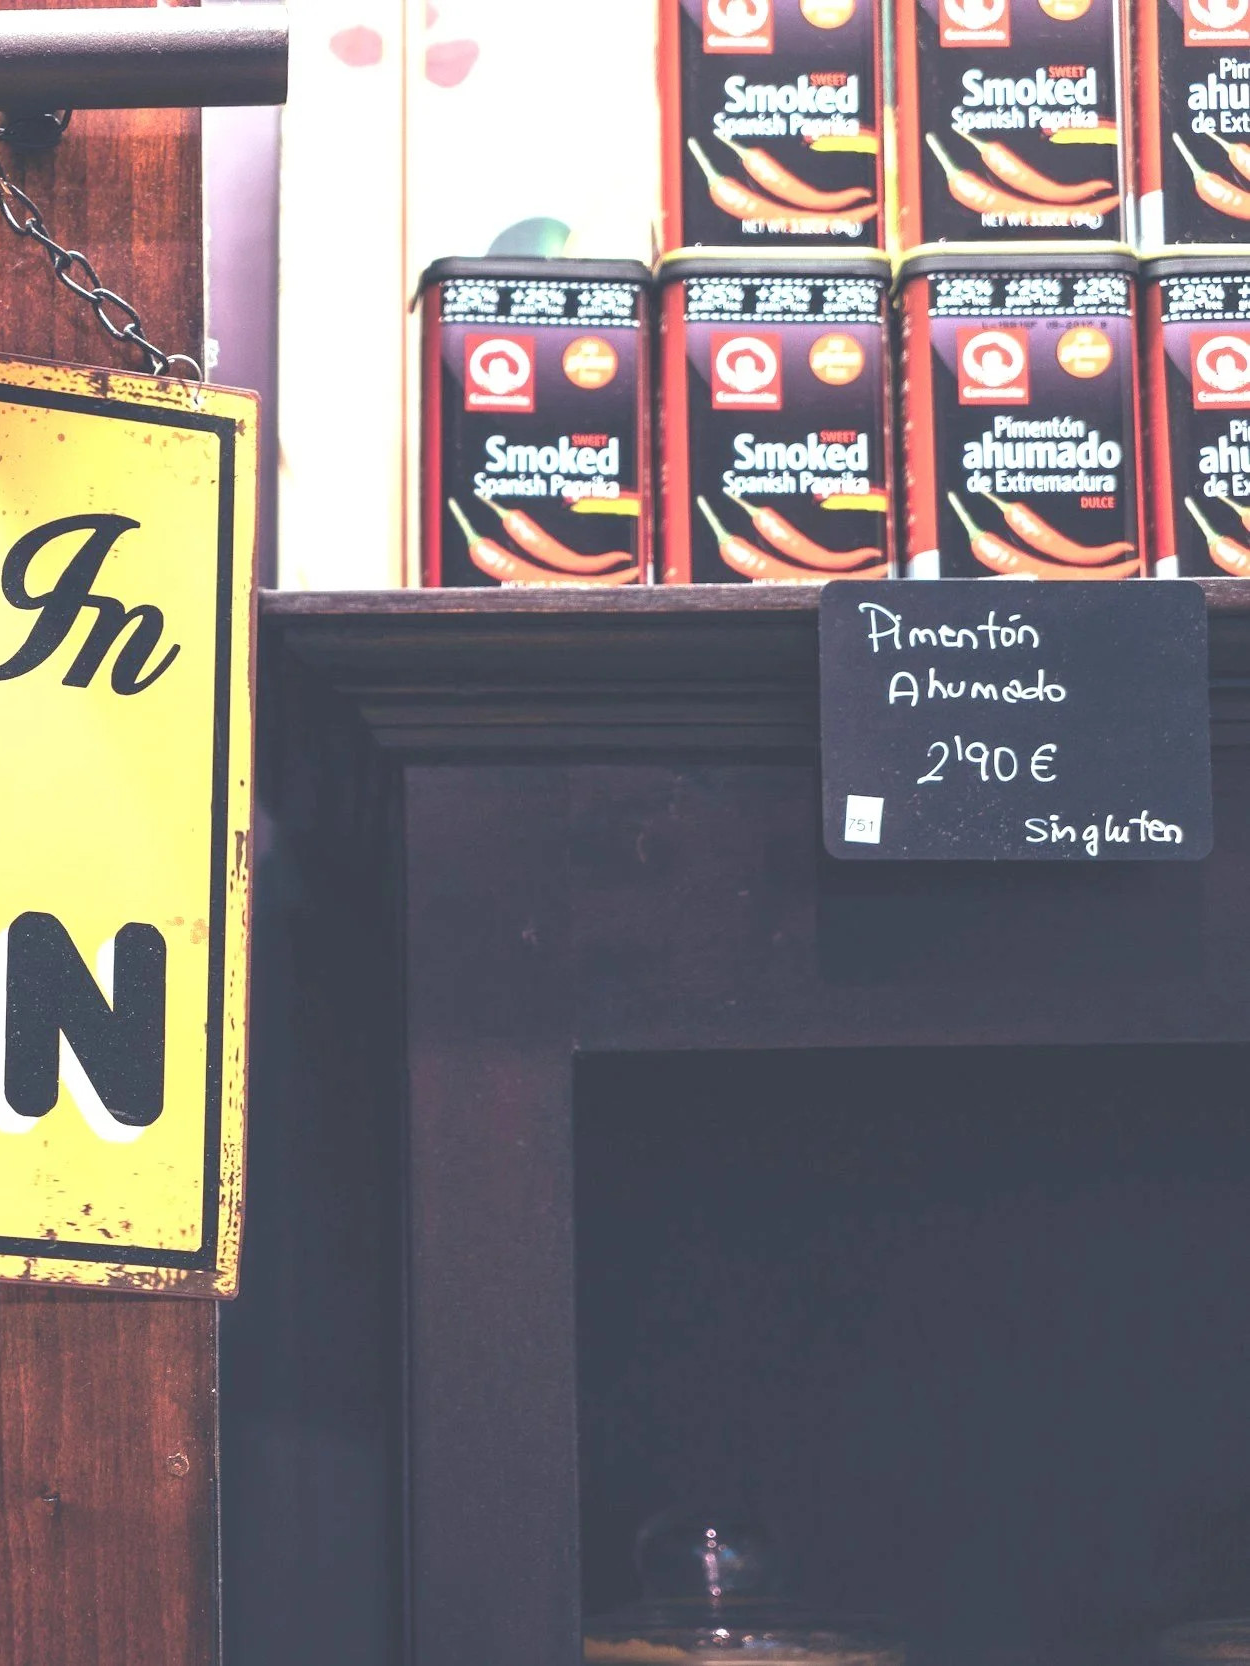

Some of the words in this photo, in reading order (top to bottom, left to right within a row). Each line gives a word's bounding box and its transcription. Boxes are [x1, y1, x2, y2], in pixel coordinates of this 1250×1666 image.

[810, 72, 848, 86] SWEET
[1049, 65, 1085, 78] SWEET
[724, 74, 859, 114] Smoked
[962, 67, 1097, 106] Smoked
[713, 112, 786, 141] Spanish
[789, 112, 859, 141] Paprika
[951, 106, 1025, 134] Spanish
[1028, 105, 1099, 132] Paprika
[1191, 111, 1216, 133] de
[1168, 284, 1225, 300] +25%
[820, 430, 857, 443] SWEET
[994, 415, 1086, 438] Pimentón
[571, 434, 607, 447] SWEET
[734, 432, 868, 471] Smoked
[962, 430, 1122, 469] ahumado
[485, 435, 619, 475] Smoked
[474, 472, 546, 500] Spanish
[550, 474, 620, 501] Paprika
[722, 470, 796, 498] Spanish
[800, 470, 869, 498] Paprika
[966, 470, 992, 493] de
[995, 469, 1117, 493] Extremadura
[1203, 473, 1228, 497] de
[1080, 496, 1116, 509] DULCE
[859, 603, 1040, 653] Pimentón
[889, 667, 1067, 706] Ahumado
[848, 818, 874, 833] 751
